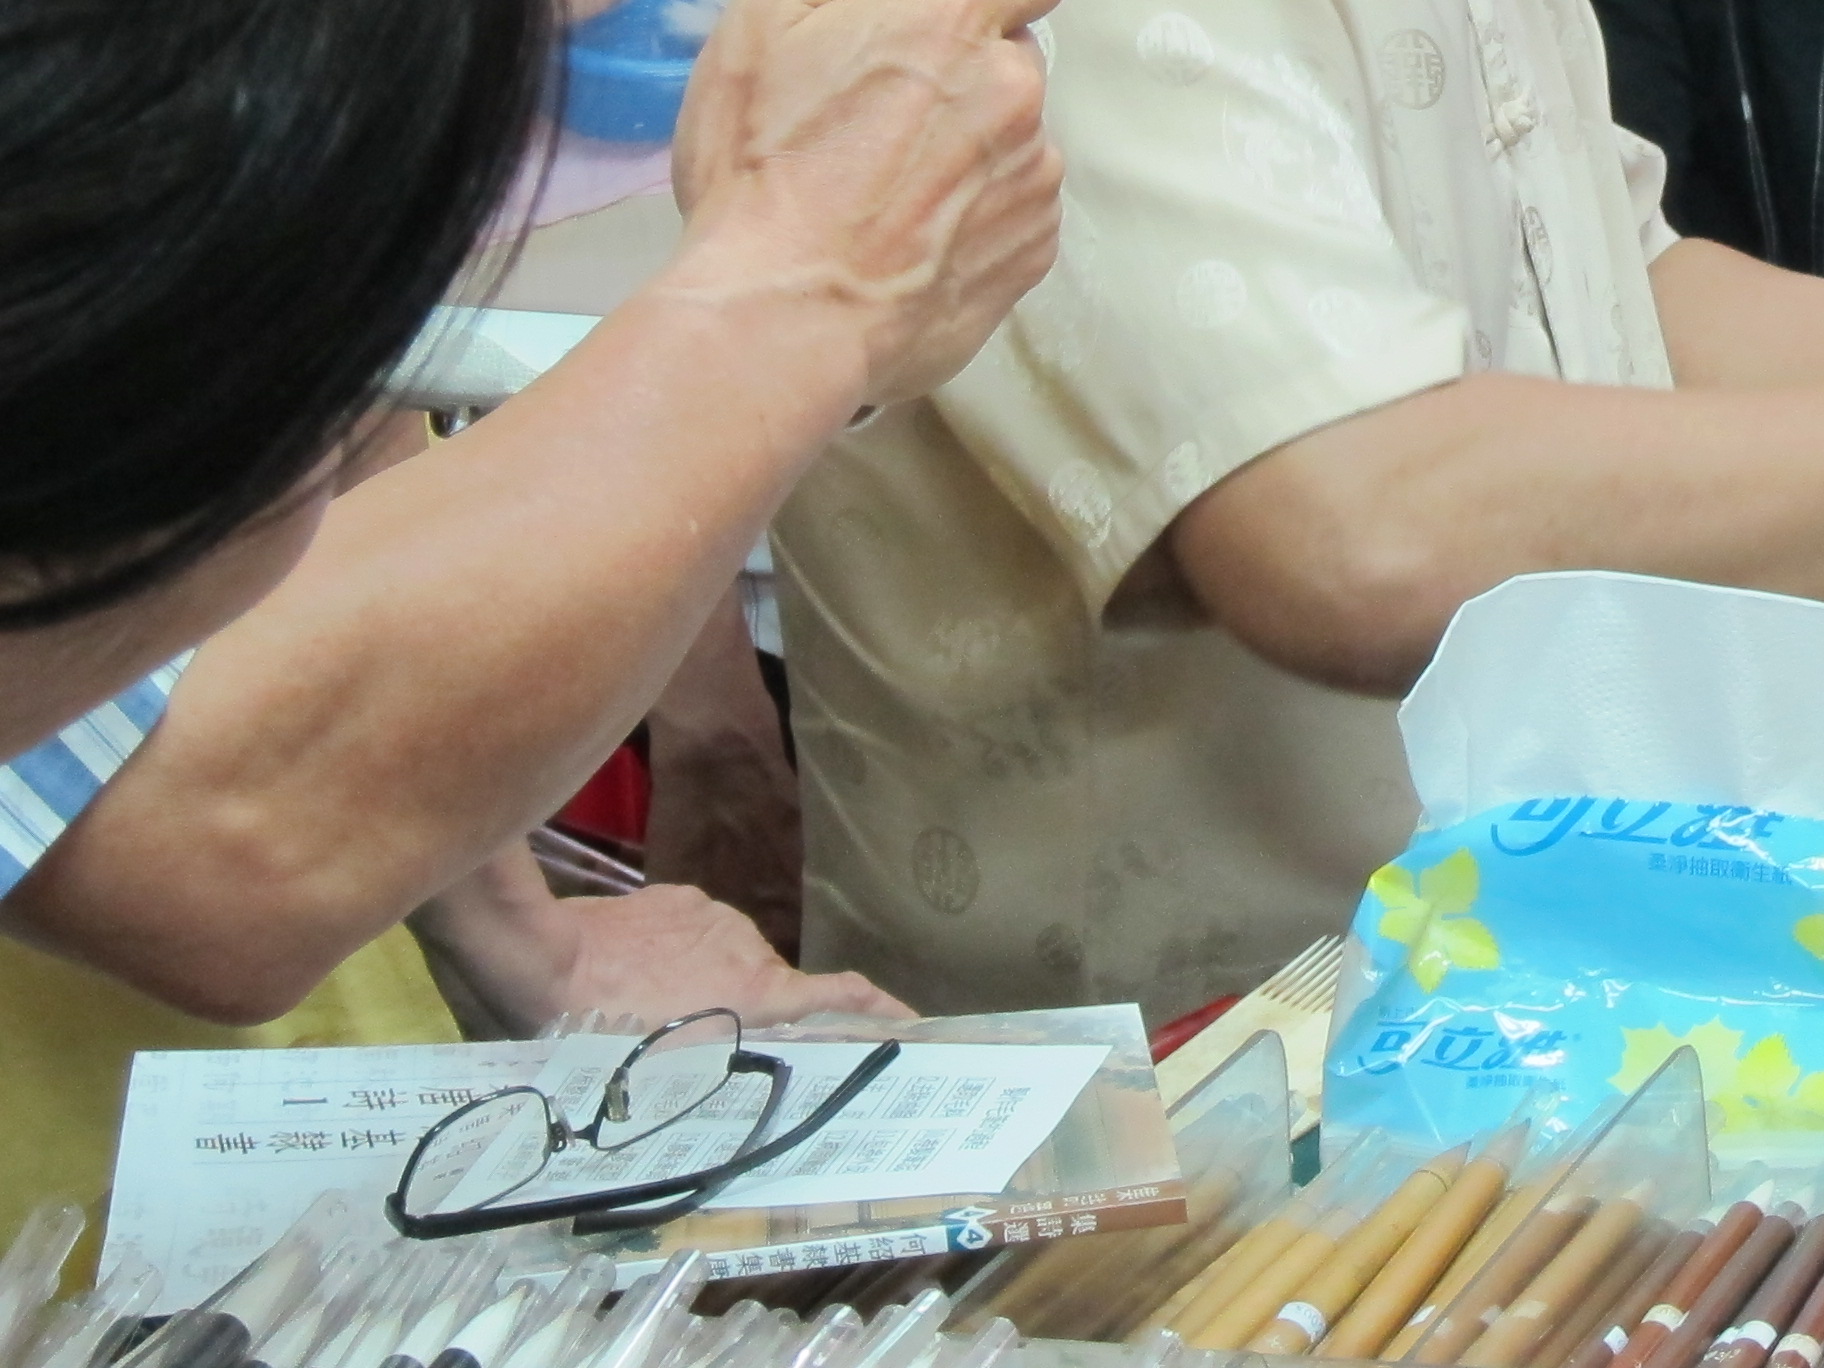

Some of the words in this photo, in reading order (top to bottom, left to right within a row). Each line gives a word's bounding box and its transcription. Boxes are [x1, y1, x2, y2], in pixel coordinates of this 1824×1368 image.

[195, 1128, 420, 1155] 基隸書
[964, 1227, 981, 1244] 4
